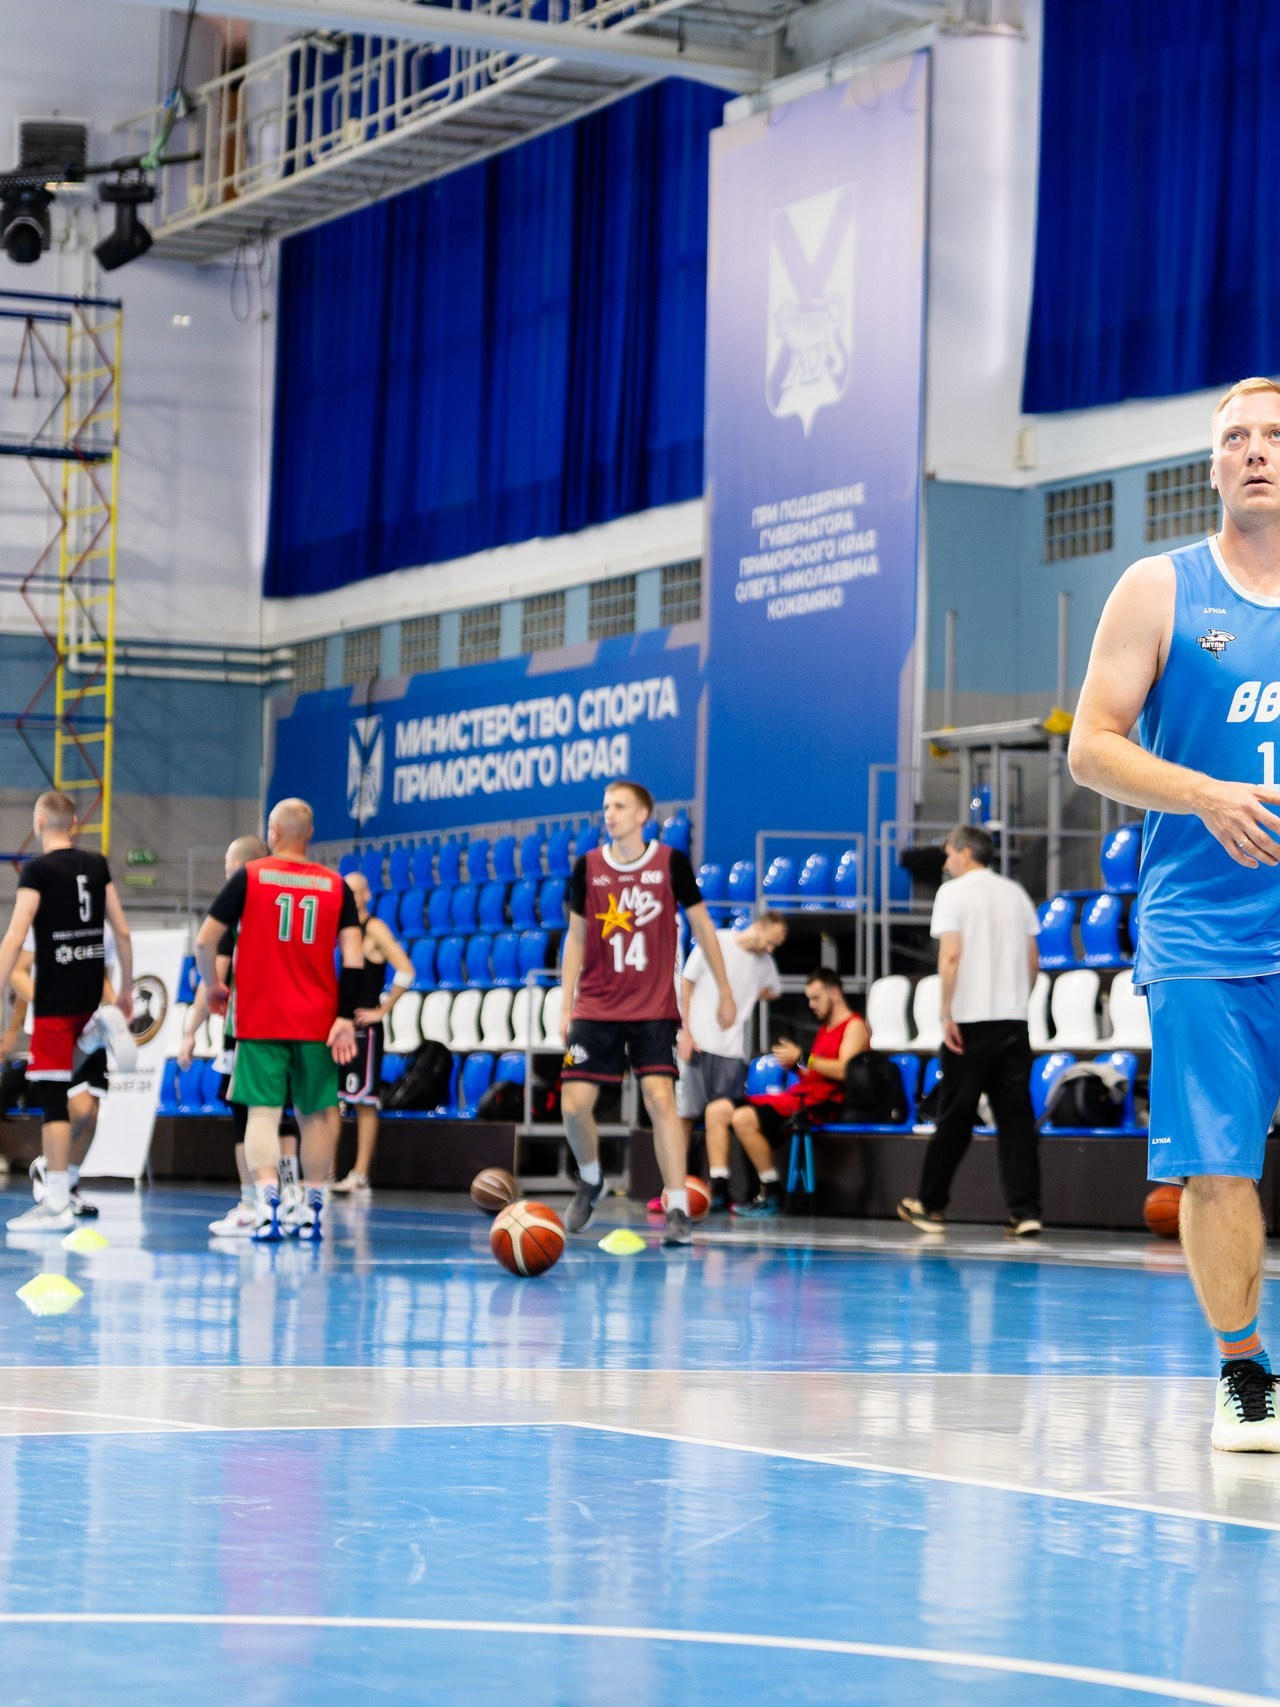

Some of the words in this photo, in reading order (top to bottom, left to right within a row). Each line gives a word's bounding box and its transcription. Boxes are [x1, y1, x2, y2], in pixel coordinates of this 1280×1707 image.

[779, 481, 866, 521] ПОДДЕРЖКЕ
[739, 538, 836, 578] ПРИМОРСКОГО
[837, 528, 878, 556] КРАЯ
[759, 510, 855, 550] ГУБЕРНАТОРА
[735, 575, 776, 604] ОЛЕГА
[778, 553, 880, 595] НИКОЛАЕВИЧА
[395, 693, 574, 760] МИНИСТЕРСТВО
[577, 676, 678, 731] СПОРТА
[393, 746, 559, 805] ПРИМОРСКОГО
[561, 732, 631, 785] КРАЯ
[76, 874, 92, 922] 5
[275, 892, 319, 944] 11
[609, 931, 649, 972] 14
